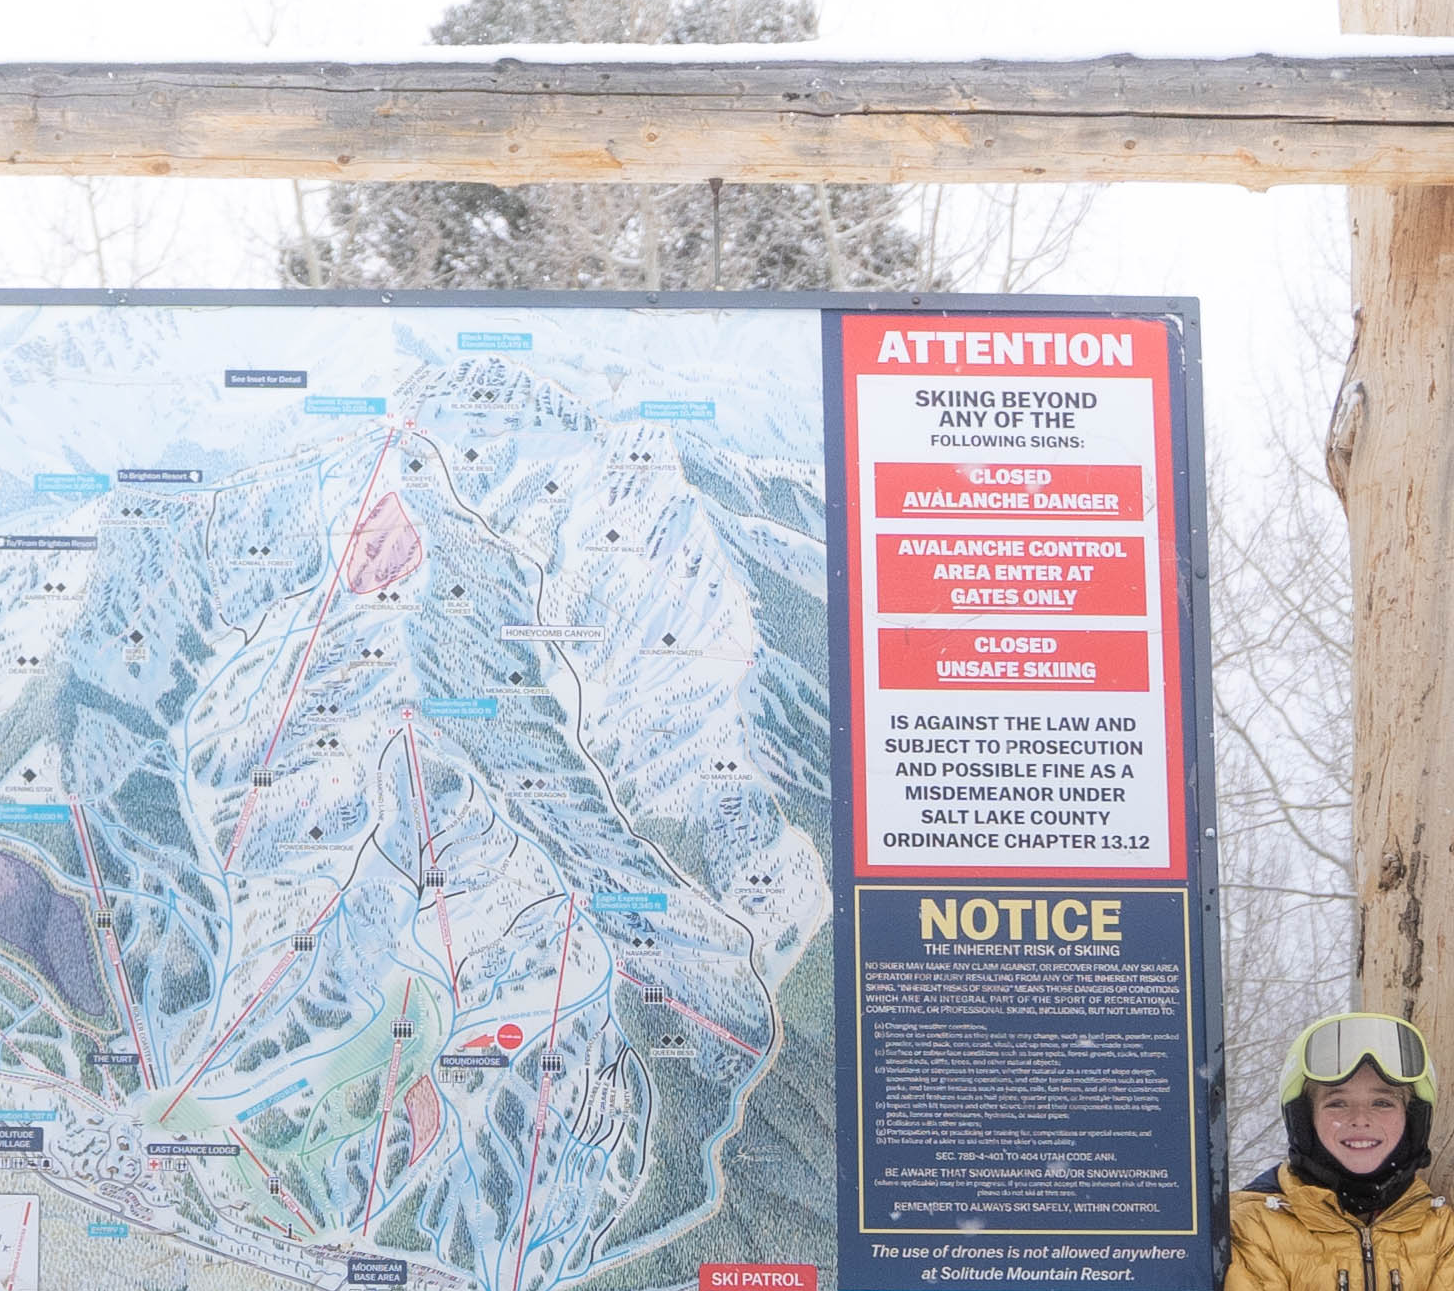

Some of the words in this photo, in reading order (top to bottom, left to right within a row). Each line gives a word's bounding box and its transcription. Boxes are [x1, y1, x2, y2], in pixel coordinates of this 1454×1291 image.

[877, 330, 1133, 366] ATTENTION
[915, 389, 995, 408] SKIING
[1002, 391, 1097, 409] BEYOND
[939, 410, 987, 427] ANY
[994, 411, 1024, 428] OF
[1029, 411, 1075, 428] THE
[930, 434, 1026, 447] FOLLOWING
[1030, 435, 1084, 448] SIGNS:
[969, 468, 1051, 485] CLOSED
[903, 491, 1030, 509] AVALANCHE
[1034, 493, 1119, 510] DANGER
[898, 539, 1024, 556] AVALANCHE
[1028, 540, 1127, 557] CONTROL
[933, 563, 990, 580] AREA
[994, 564, 1062, 581] ENTER
[1066, 565, 1094, 581] AT
[950, 587, 1019, 607] GATES
[1022, 588, 1077, 607] ONLY
[505, 629, 562, 639] HONEYCOMB
[564, 629, 601, 639] CANYON
[974, 636, 1057, 653] CLOSED
[936, 660, 1021, 680] UNSAFE
[1020, 661, 1096, 680] SKIING
[891, 715, 909, 729] IS
[914, 715, 999, 730] AGAINST
[1003, 716, 1041, 731] THE
[1046, 716, 1089, 731] LAW
[1095, 717, 1136, 732] AND
[885, 738, 970, 754] SUBJECT
[974, 739, 1000, 754] TO
[1005, 739, 1142, 755] PROSECUTION
[895, 761, 936, 776] AND
[942, 762, 1036, 778] POSSIBLE
[1042, 763, 1084, 778] FINE
[1090, 763, 1115, 778] AS
[1120, 764, 1134, 778] A
[905, 785, 1053, 801] MISDEMEANOR
[1059, 787, 1125, 802] UNDER
[921, 809, 969, 824] SALT
[974, 809, 1025, 824] LAKE
[1030, 810, 1110, 825] COUNTY
[883, 832, 999, 848] ORDINANCE
[1004, 833, 1096, 849] CHAPTER
[1101, 835, 1149, 849] 13.12
[920, 898, 1122, 941] NOTICE
[923, 943, 950, 955] THE
[953, 943, 1021, 955] INHERENT
[1023, 944, 1055, 956] RISK
[1058, 944, 1071, 956] of
[1074, 944, 1120, 956] SKIING
[93, 1054, 109, 1062] THE
[110, 1055, 133, 1063] YURT
[443, 1056, 501, 1066] ROUNDHOUSE
[149, 1146, 171, 1155] LAST
[172, 1147, 207, 1155] CHANCE
[208, 1147, 237, 1155] LODGE
[871, 1244, 899, 1257] The
[902, 1247, 929, 1258] use
[932, 1244, 949, 1258] of
[951, 1244, 1003, 1258] drones
[1007, 1245, 1019, 1258] is
[1022, 1245, 1049, 1258] not
[1051, 1245, 1110, 1259] allowed
[351, 1263, 402, 1272] MOONBEAM
[921, 1267, 938, 1279] at
[940, 1266, 1003, 1280] Solitude
[1006, 1266, 1077, 1280] Mountain
[1080, 1266, 1134, 1280] Resort.
[353, 1273, 376, 1282] BASE
[377, 1274, 401, 1282] AREA
[711, 1272, 738, 1286] SKI
[742, 1272, 804, 1286] PATROL
